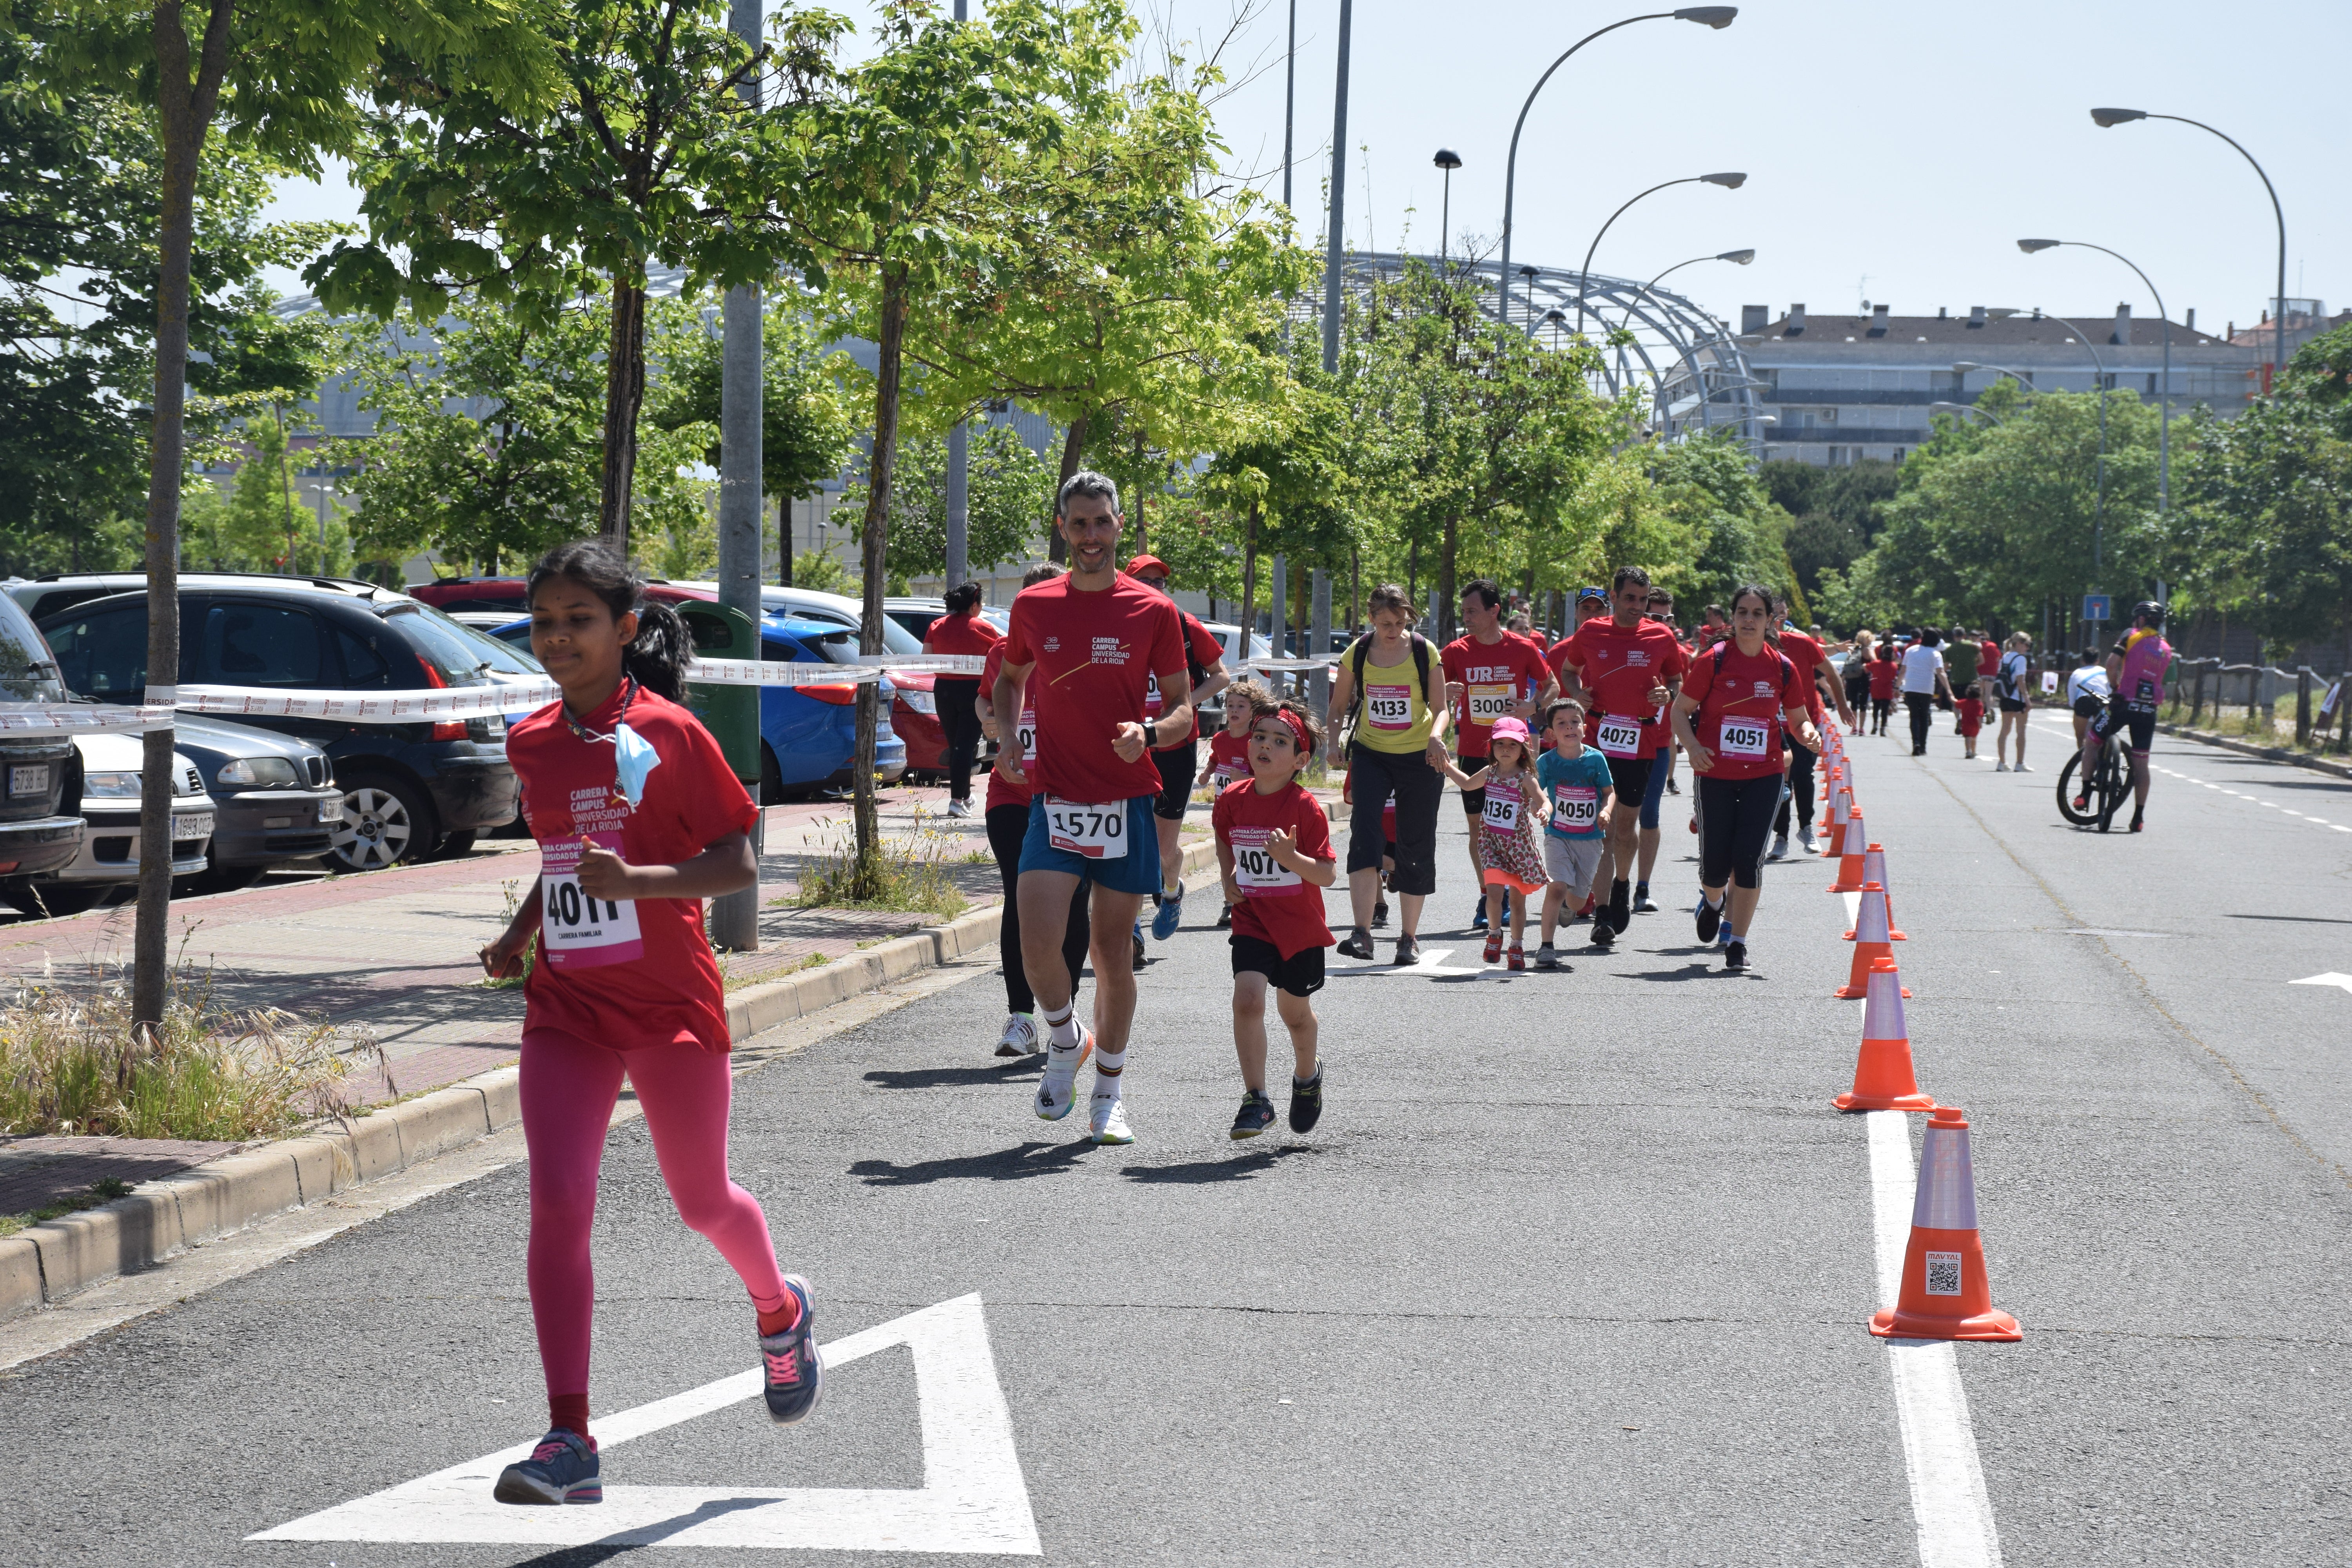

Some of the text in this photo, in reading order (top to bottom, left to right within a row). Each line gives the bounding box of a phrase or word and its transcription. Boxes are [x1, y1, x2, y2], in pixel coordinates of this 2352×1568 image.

[1465, 666, 1493, 682] UR
[1371, 700, 1407, 716] 4133
[1600, 727, 1637, 745] 4073
[1724, 728, 1763, 746] 4051
[570, 786, 609, 801] CARRERA
[571, 798, 606, 813] CAMPUS
[1484, 799, 1514, 820] 4136
[1557, 800, 1594, 818] 4050
[572, 807, 628, 823] UNIVERSIDAD
[575, 819, 624, 835] DE LA RIOJA
[1053, 813, 1122, 838] 1570
[555, 842, 584, 851] CAMPUS
[558, 930, 602, 940] CARRERA FAMILIAR
